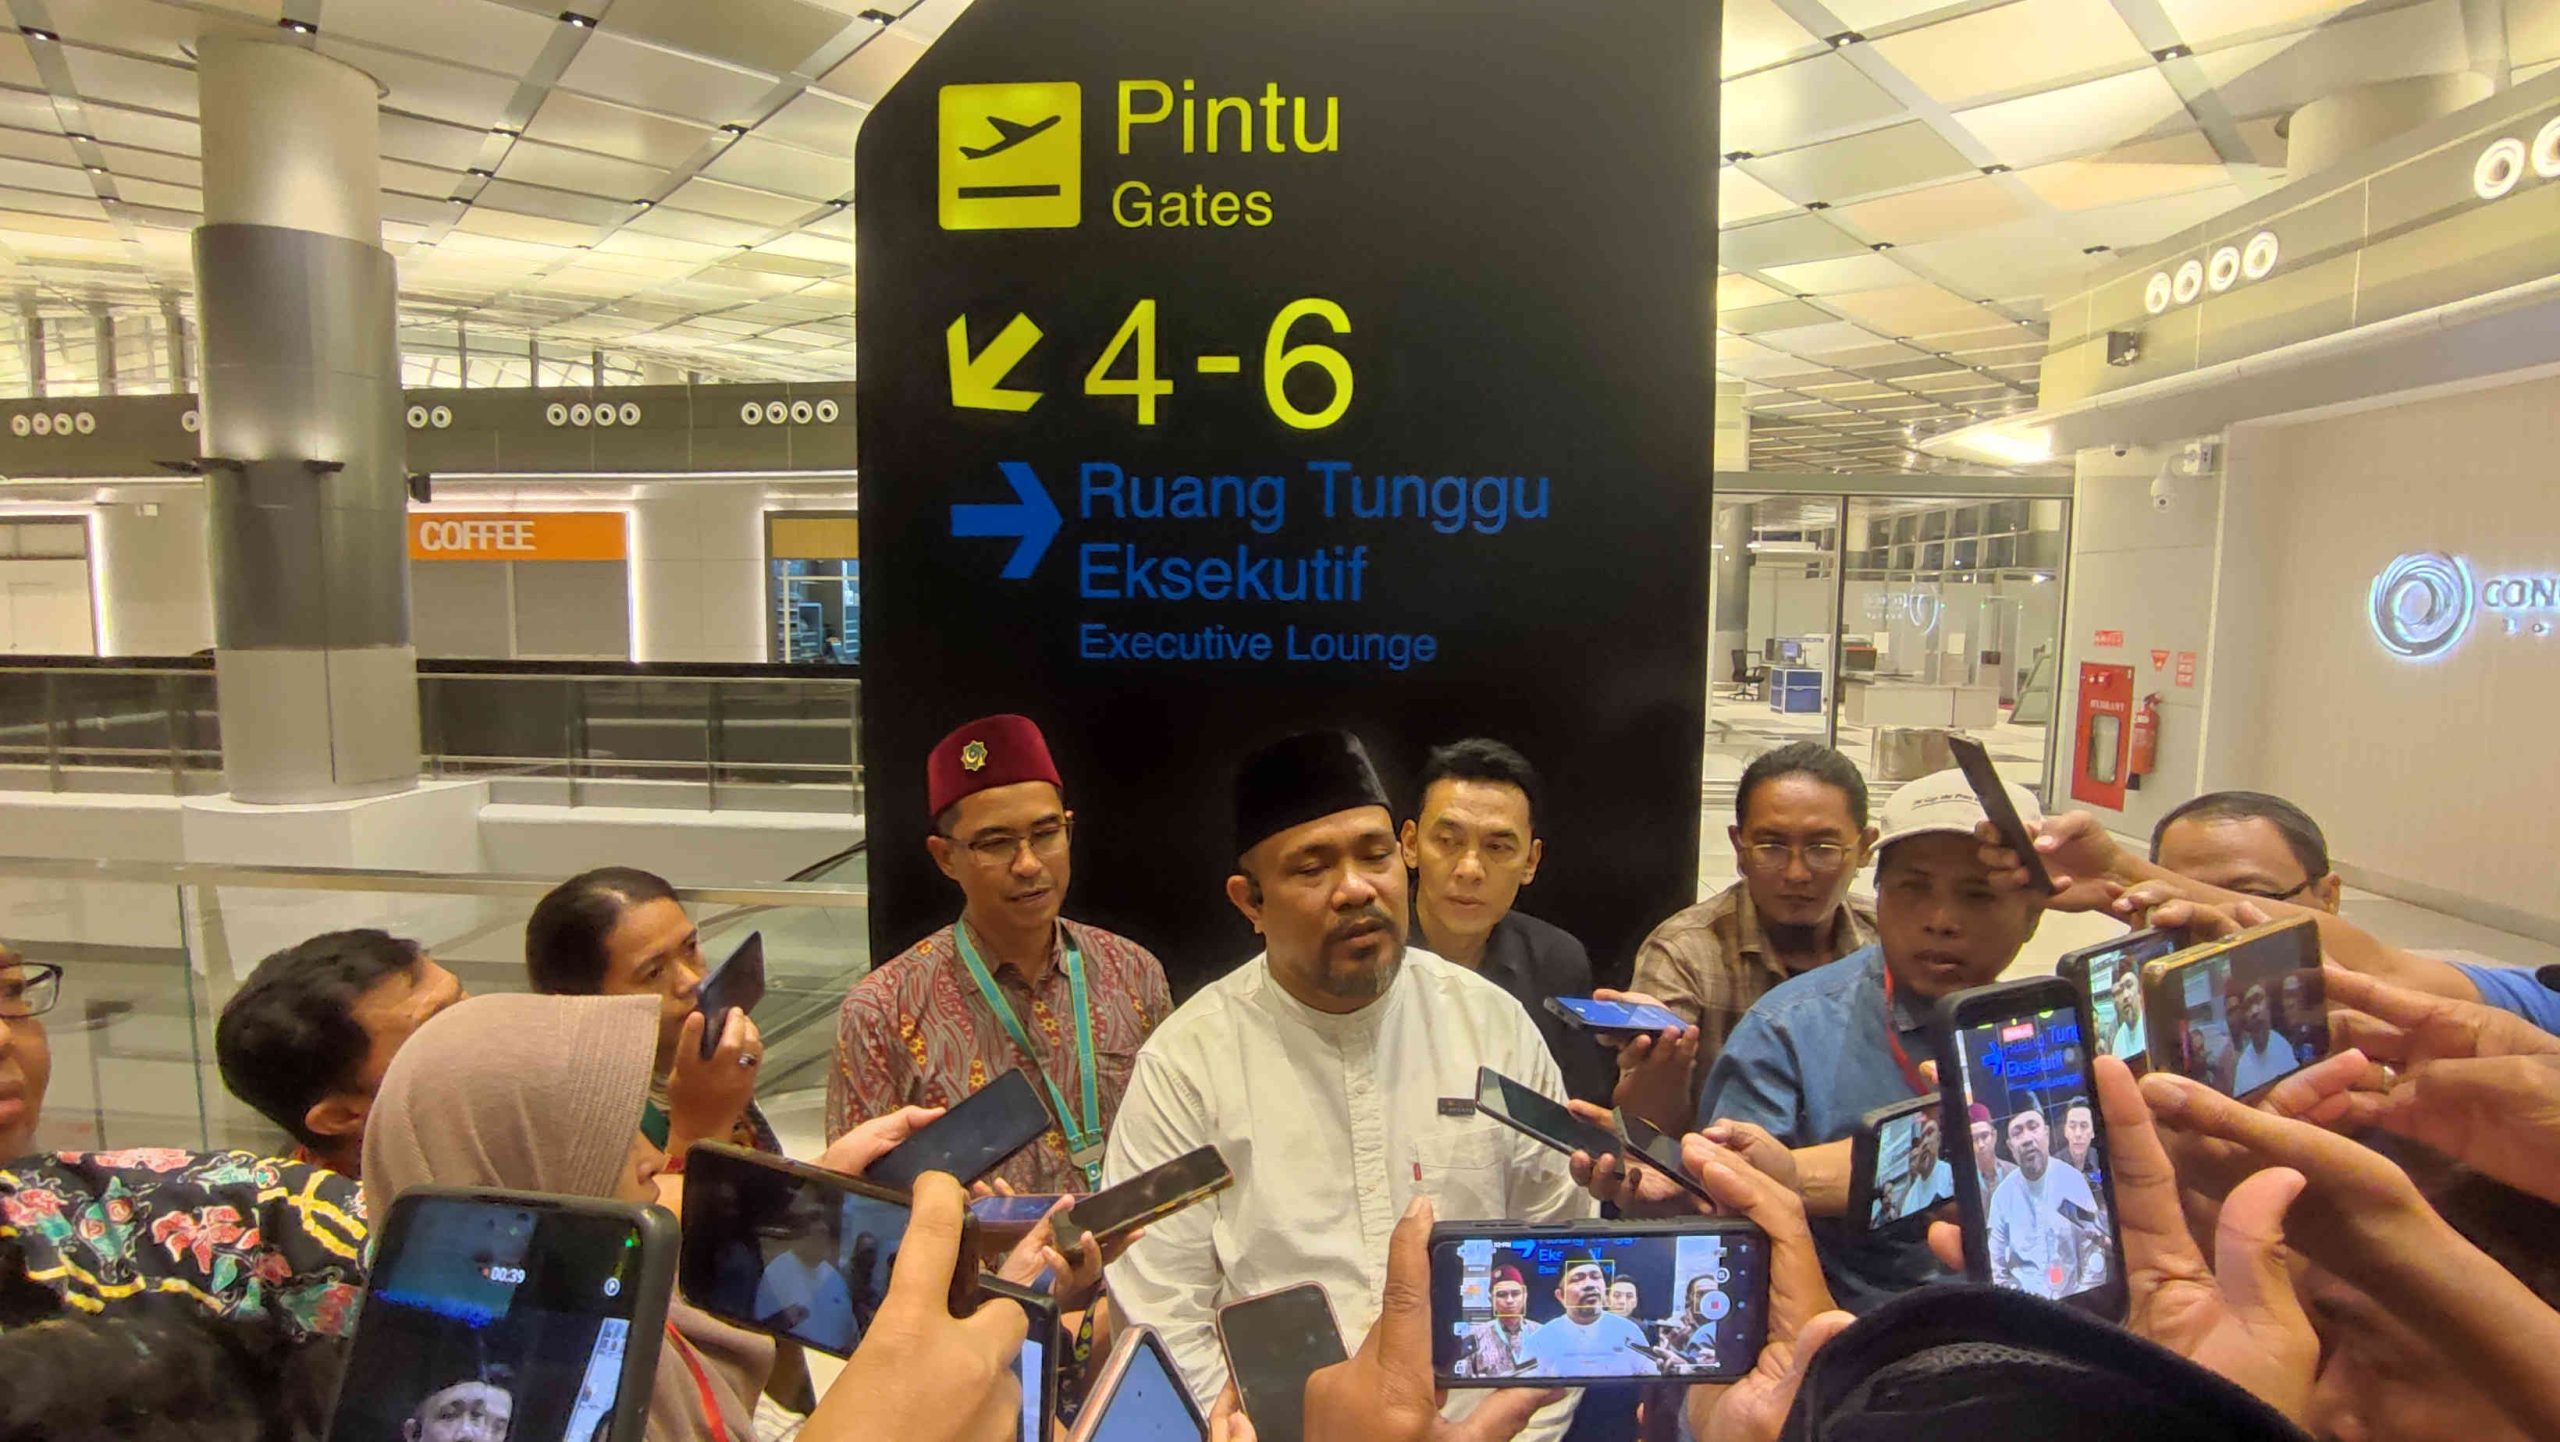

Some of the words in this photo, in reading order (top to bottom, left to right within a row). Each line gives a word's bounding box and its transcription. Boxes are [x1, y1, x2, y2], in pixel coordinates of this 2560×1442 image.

[1118, 79, 1339, 154] Pintu
[1112, 181, 1274, 228] Gates
[1084, 298, 1354, 430] 4-6
[1080, 462, 1285, 533] Ruang
[1307, 461, 1549, 534] Tunggu
[420, 520, 537, 551] COFFEE
[1079, 543, 1367, 602] Eksekutif
[1079, 624, 1272, 661] Executive
[1287, 625, 1437, 671] Lounge
